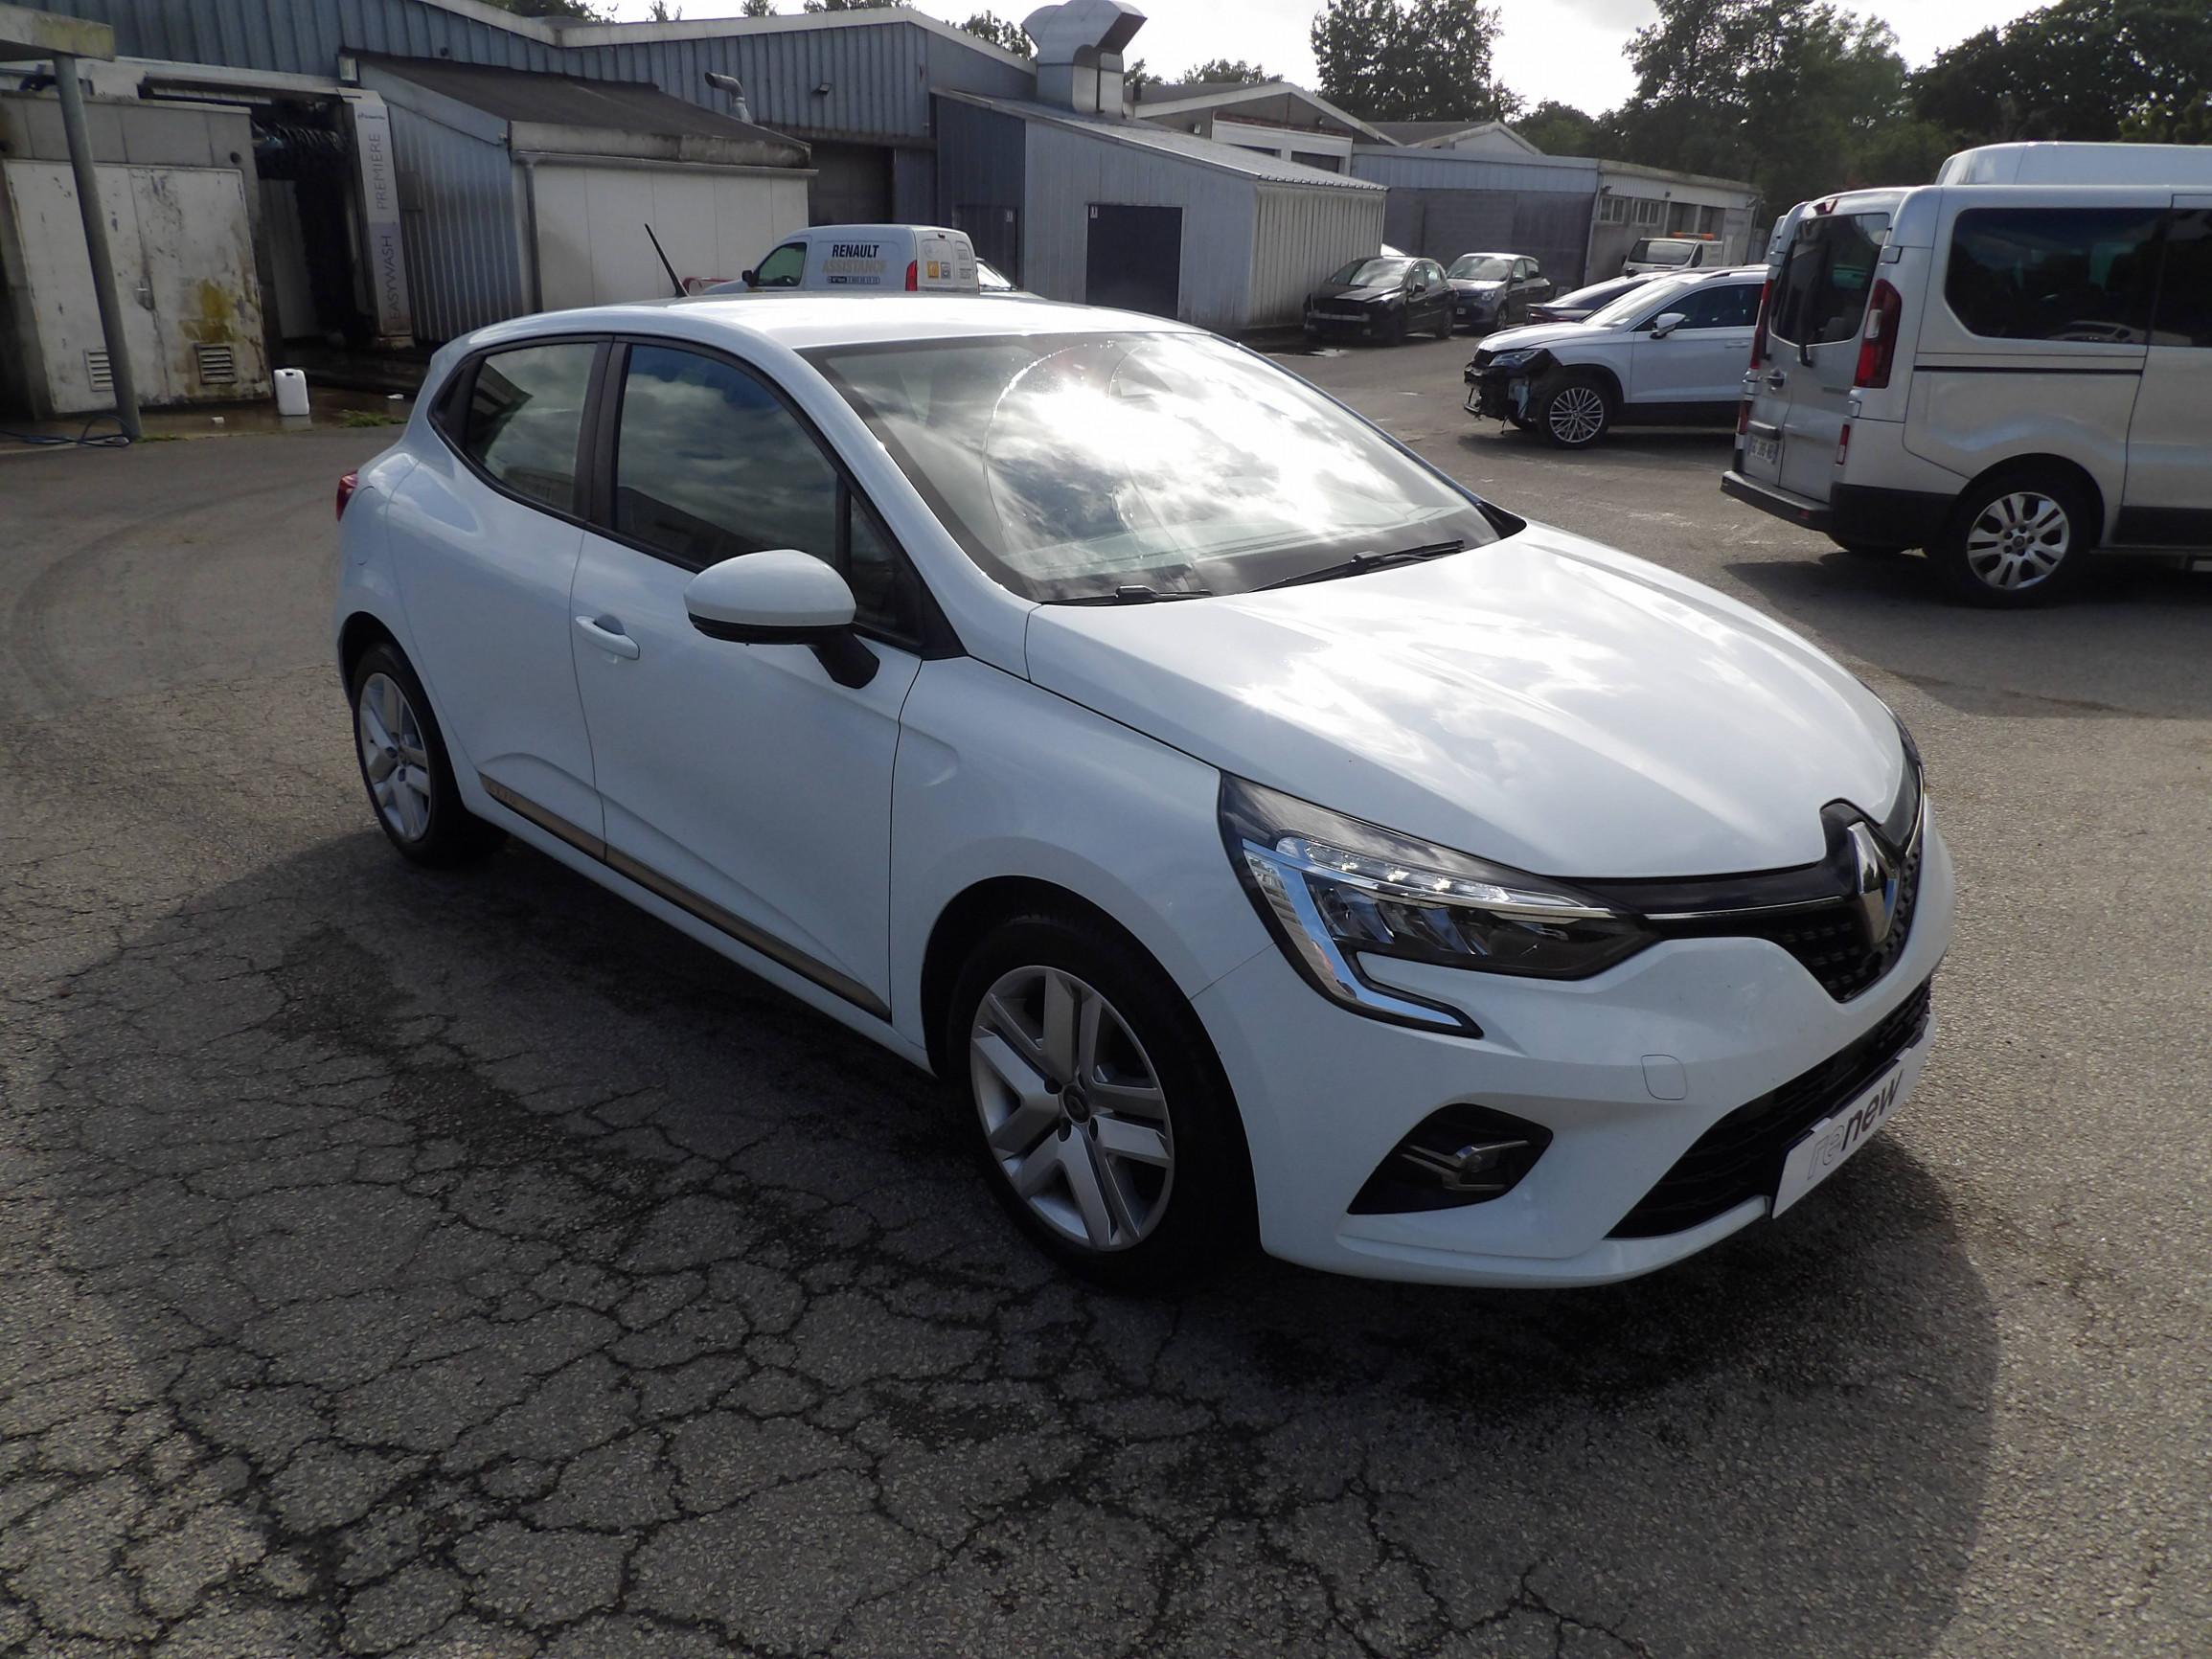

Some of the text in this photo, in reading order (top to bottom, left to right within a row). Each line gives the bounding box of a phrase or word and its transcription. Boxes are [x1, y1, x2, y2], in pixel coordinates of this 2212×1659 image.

[822, 260, 887, 274] ASSISTANCE
[832, 244, 879, 259] RENAULT
[381, 236, 399, 320] EASYWASH
[1807, 1068, 1904, 1180] renew
